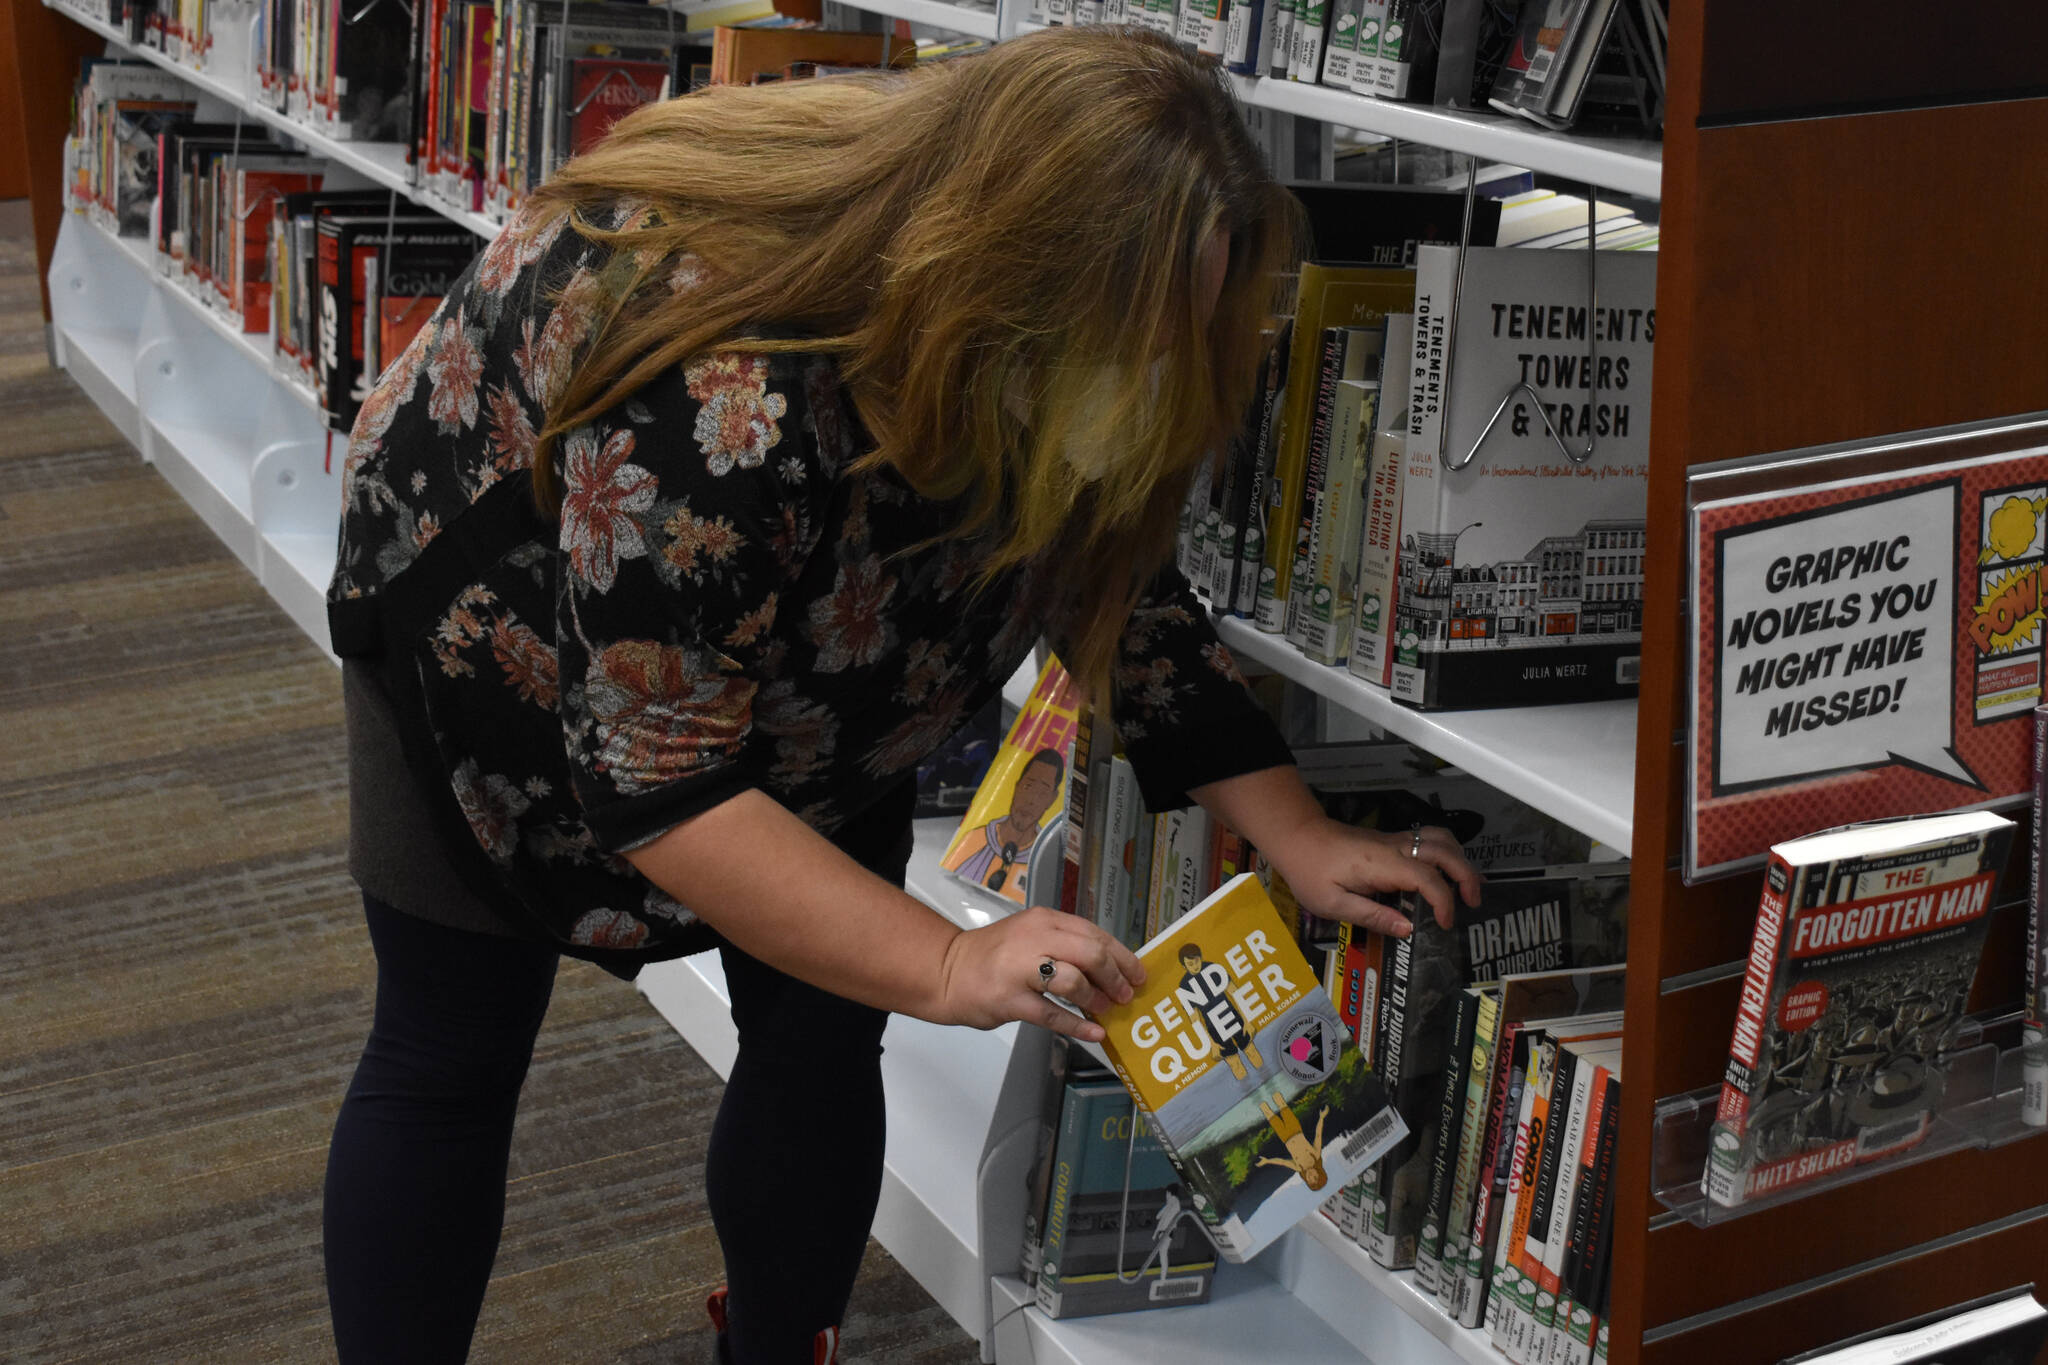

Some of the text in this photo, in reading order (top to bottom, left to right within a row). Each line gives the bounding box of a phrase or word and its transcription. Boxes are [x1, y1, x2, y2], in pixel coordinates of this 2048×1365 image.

[1372, 246, 1400, 263] THE
[1324, 342, 1336, 361] THE
[1411, 295, 1431, 436] TOWERS & TRASH
[1518, 354, 1630, 390] TOWERS
[1318, 367, 1334, 414] HARLEM
[1511, 403, 1630, 437] & TRASH
[1249, 389, 1276, 523] WONDERFUL WOMEN
[1305, 418, 1325, 501] HELLFIGHTERS
[1385, 452, 1400, 496] LIVING
[1409, 466, 1433, 479] WERTZ
[1411, 451, 1432, 464] JULIA
[1368, 471, 1385, 547] IN AMERICA
[1379, 511, 1393, 551] DYING
[1308, 551, 1318, 585] PEKA
[1765, 535, 1910, 594] GRAPHIC
[1727, 578, 1938, 650] NOVELS YOU
[1522, 664, 1589, 680] JULIA WERTZ
[1735, 627, 1927, 696] MIGHT HAVE
[1764, 677, 1908, 738] MISSED!
[1105, 775, 1126, 921] SOLUTIONS PROBLEMS
[1480, 834, 1501, 844] THE
[1849, 862, 1868, 872] NEW
[1871, 859, 1895, 869] YORK
[1897, 852, 1924, 865] TIMES
[1926, 843, 1977, 861] BESTSELLER
[1769, 875, 1785, 891] EDITION
[1770, 865, 1788, 884] GRAPHIC
[1884, 867, 1926, 889] THE
[2026, 798, 2043, 987] GREAT AMERICAN DUST
[1763, 892, 1783, 914] THE
[1794, 879, 1989, 951] FORGOTTEN MAN
[1468, 900, 1562, 965] DRAWN
[1811, 957, 1829, 967] NEW
[1831, 951, 1864, 964] HISTORY
[1879, 944, 1893, 954] THE
[1895, 938, 1920, 950] GREAT
[1921, 926, 1967, 945] DEPRESSION
[1472, 941, 1564, 982] TO PURPOSE
[1130, 929, 1277, 1050] GENDER
[1349, 968, 1360, 1016] GOOD
[1365, 979, 1374, 1011] JAMES
[1731, 904, 1781, 1065] FORGOTTEN MAN
[1787, 990, 1822, 1008] GRAPHIC
[1150, 964, 1297, 1084] QUEER
[1258, 990, 1301, 1026] MAIA KOBABE
[1380, 997, 1390, 1032] FRIDA
[1785, 1005, 1817, 1022] EDITION
[1283, 1016, 1314, 1043] Stonewall
[1385, 985, 1407, 1087] TO PURPOSE
[1328, 1039, 1338, 1062] Book
[1729, 1060, 1750, 1079] AMITY
[1174, 1062, 1209, 1092] A MEMOIR
[1291, 1067, 1316, 1080] Honor
[1444, 1069, 1459, 1103] THREE
[1491, 1037, 1512, 1111] WOMAN
[1725, 1071, 1750, 1093] SHLAES
[1115, 1062, 1152, 1119] GENDER
[1151, 1123, 1184, 1170] QUEER
[1596, 1091, 1605, 1111] THE
[1608, 1104, 1618, 1127] THE
[1438, 1105, 1454, 1147] ESCAPES
[1483, 1114, 1500, 1168] REBEL
[1534, 1068, 1567, 1220] THE ARAB OF THE FUTURE
[1451, 1097, 1477, 1211] BELONGING
[1522, 1116, 1543, 1187] GONZO
[1551, 1080, 1586, 1246] THE ARAB OF THE FUTURE 2
[1602, 1133, 1614, 1165] ARAB
[1744, 1165, 1792, 1195] AMITY
[1797, 1142, 1857, 1178] SHLAES
[1429, 1156, 1446, 1206] HANNAH
[1582, 1171, 1593, 1192] THE
[1594, 1185, 1606, 1206] THE
[1049, 1161, 1071, 1248] COMMUTE
[1573, 1195, 1589, 1241] FUTURE
[1586, 1208, 1603, 1256] FUTURE
